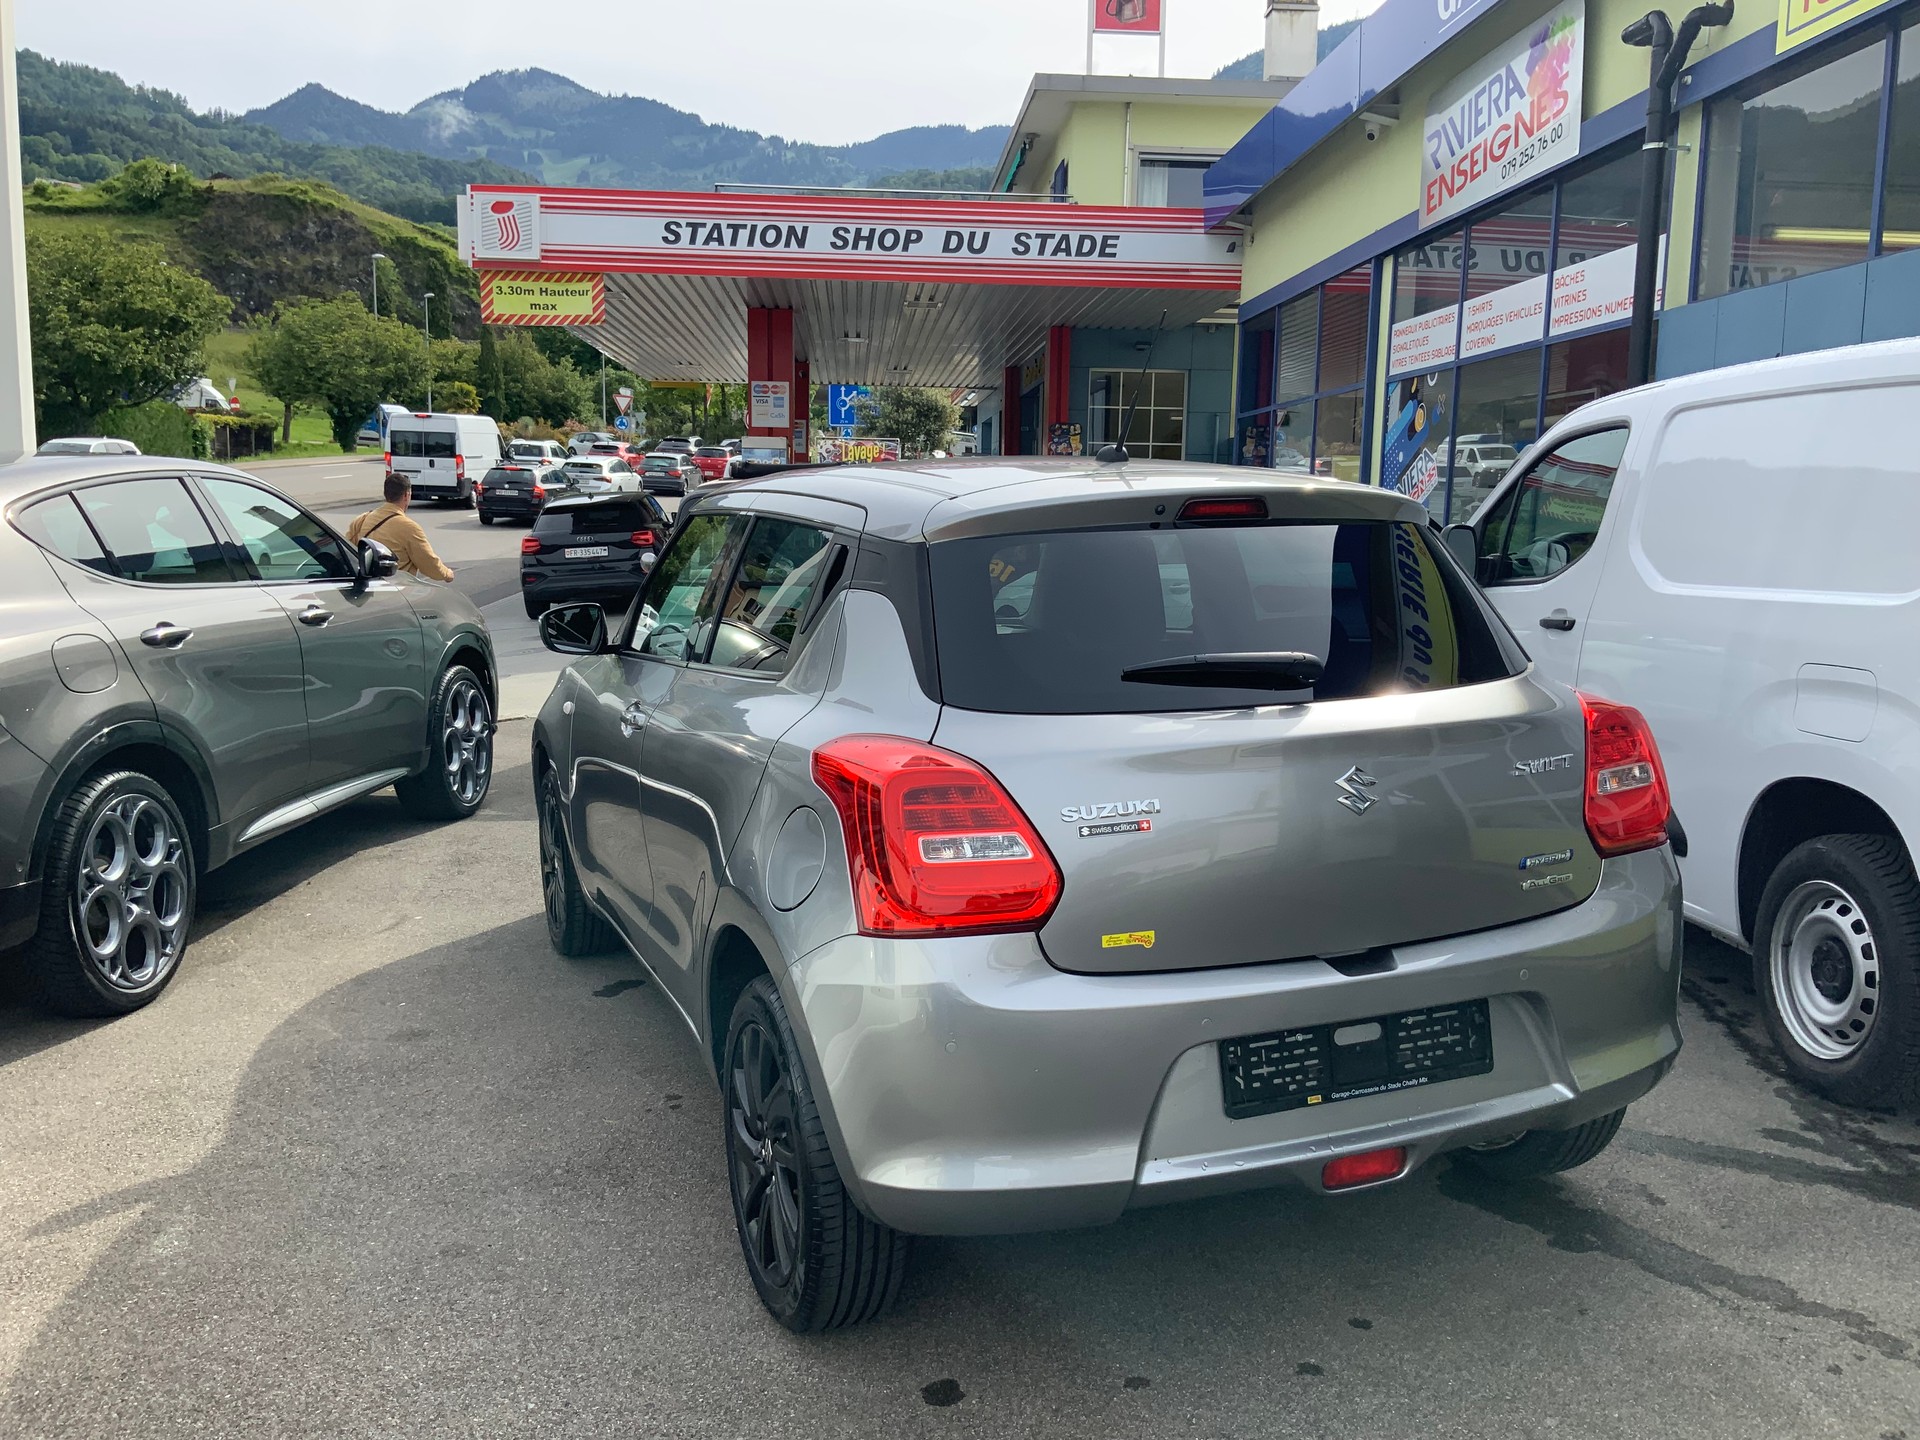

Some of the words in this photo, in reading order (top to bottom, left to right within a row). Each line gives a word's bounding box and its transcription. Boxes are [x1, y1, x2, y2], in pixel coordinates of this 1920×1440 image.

[1426, 64, 1526, 170] RIVIERA
[1427, 71, 1569, 216] ENSEIGNES
[1501, 158, 1517, 180] 079
[1519, 144, 1535, 169] 252
[1537, 136, 1549, 155] 76
[1551, 122, 1563, 144] 00
[661, 221, 810, 249] STATION
[830, 226, 924, 253] SHOP
[941, 230, 991, 255] DU
[1011, 232, 1121, 259] STADE
[495, 285, 535, 297] 3.30m
[539, 287, 591, 297] Hauteur
[1553, 289, 1587, 309] VITRINES
[529, 302, 558, 311] max
[1467, 299, 1493, 317] T-SHIRTS
[1552, 304, 1603, 328] IMPRESSIONS
[1466, 314, 1504, 334] MARQUAGES
[1505, 302, 1543, 323] VEHICULES
[1392, 335, 1430, 355] SIGNALETIQUES
[1465, 334, 1496, 352] COVERING
[842, 441, 880, 463] Lavage
[1513, 753, 1574, 776] SWIFT
[1061, 799, 1161, 822] SUZUKI
[1091, 826, 1112, 835] swiss
[1113, 823, 1138, 832] edition
[1331, 1085, 1379, 1098] Garage-Carrosserie
[1387, 1082, 1402, 1090] Stade
[1402, 1079, 1419, 1088] Chailly
